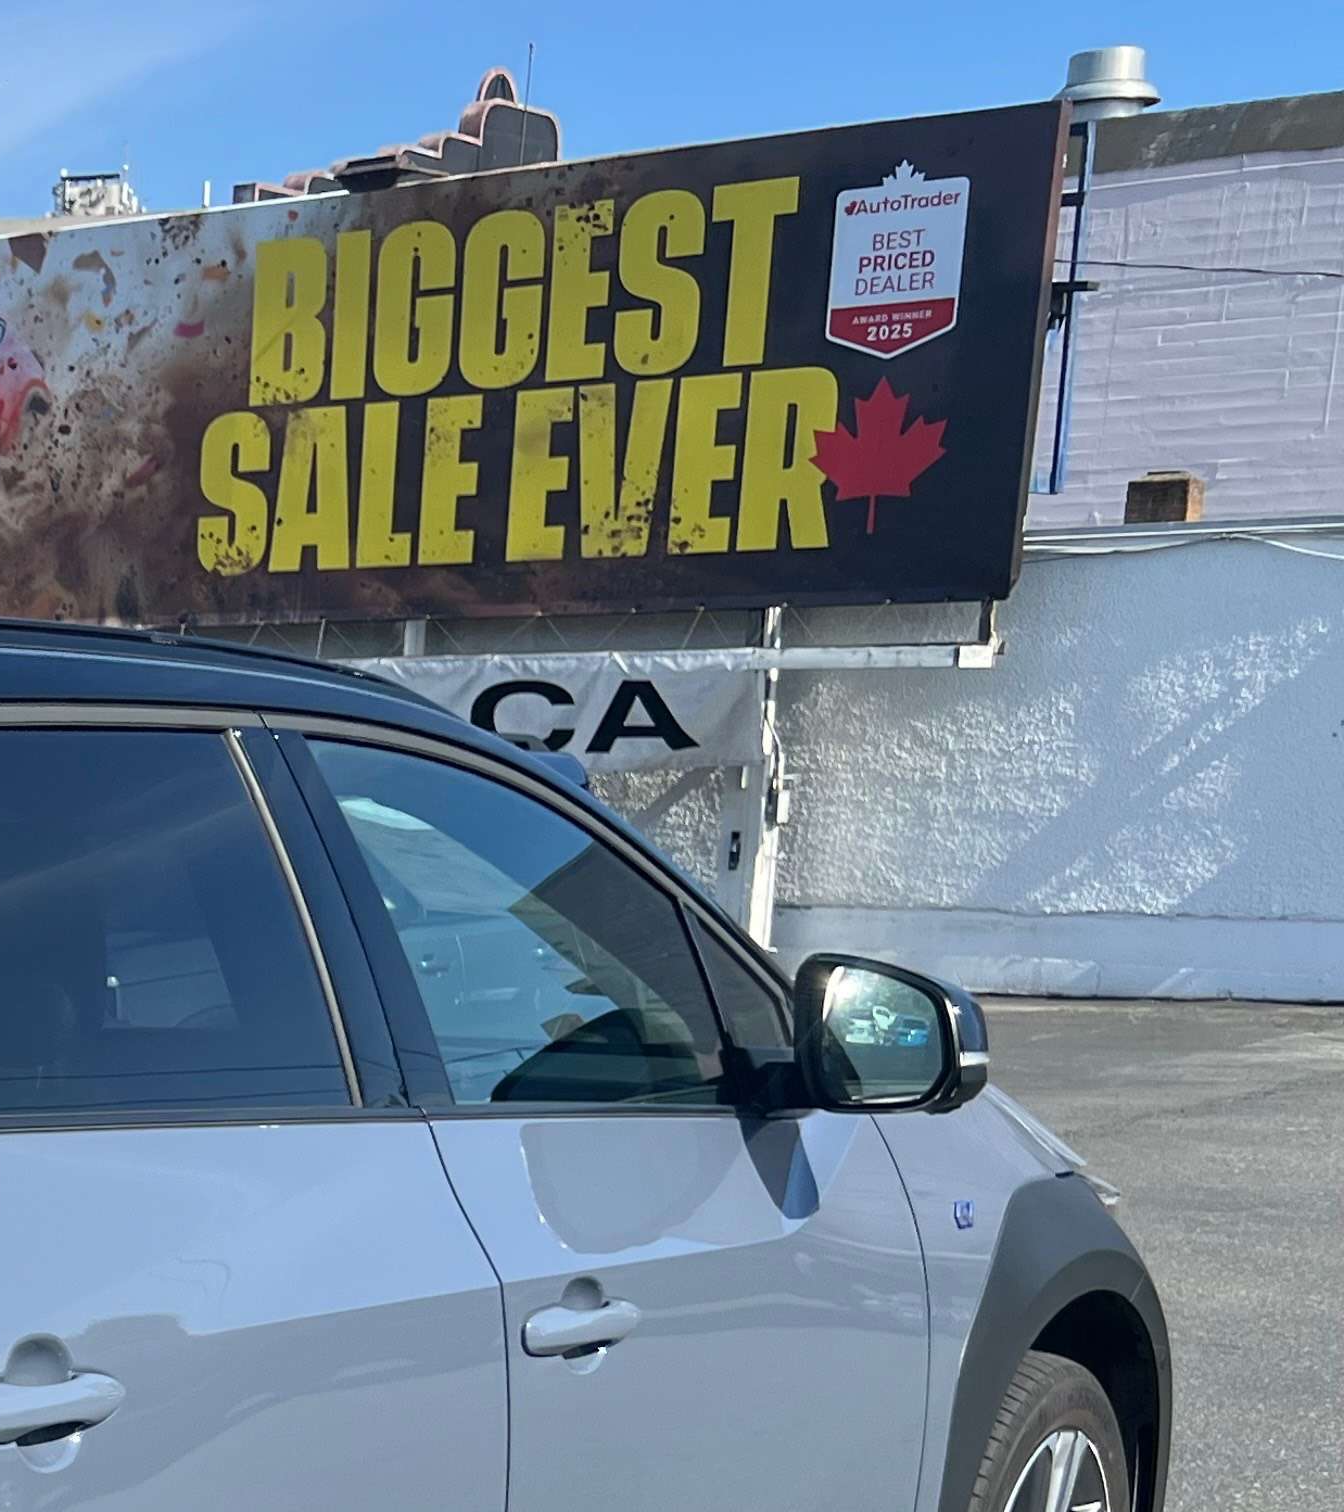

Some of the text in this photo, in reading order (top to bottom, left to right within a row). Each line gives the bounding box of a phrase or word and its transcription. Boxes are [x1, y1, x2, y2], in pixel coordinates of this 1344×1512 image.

[855, 191, 961, 216] AutoTrader
[872, 228, 926, 251] BEST
[858, 249, 935, 274] PRICED
[248, 175, 801, 407] BIGGEST
[854, 271, 935, 296] DEALER
[852, 309, 933, 325] AWARD WINNER
[866, 323, 913, 342] 2025
[197, 366, 839, 578] SALE EVER
